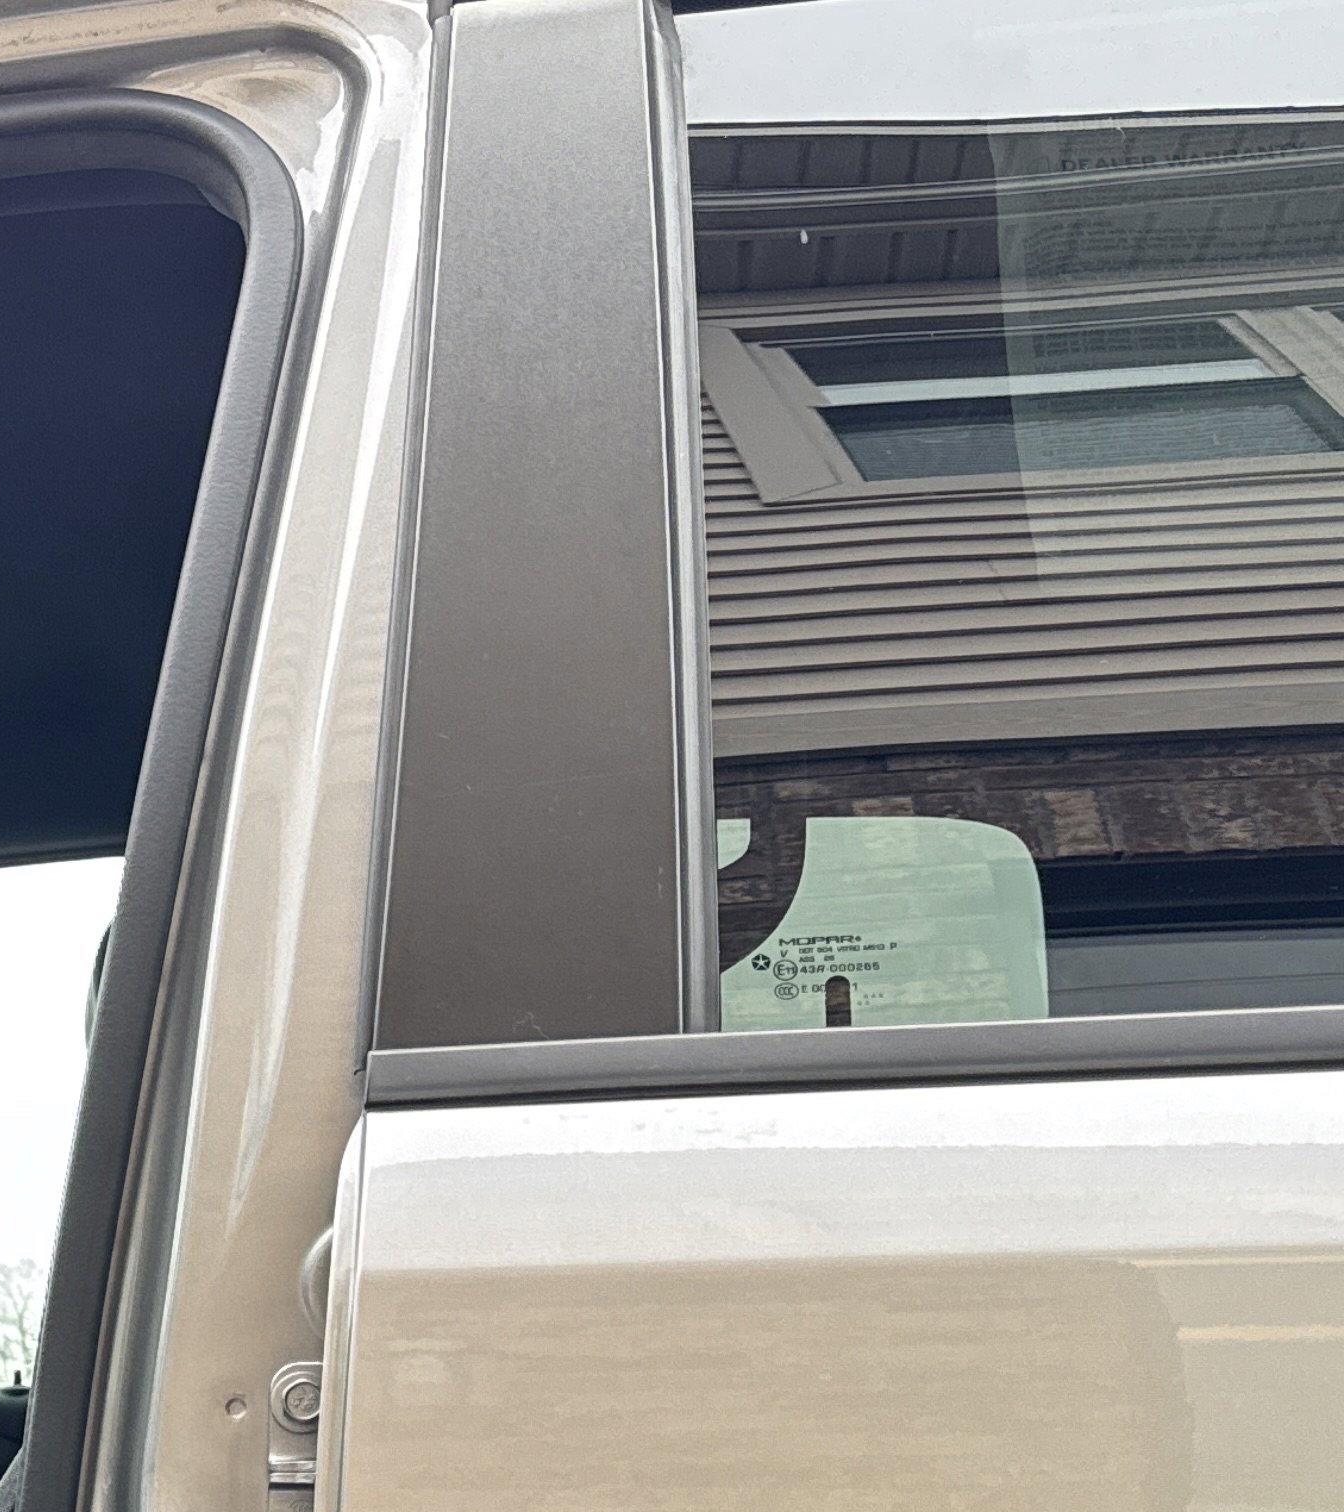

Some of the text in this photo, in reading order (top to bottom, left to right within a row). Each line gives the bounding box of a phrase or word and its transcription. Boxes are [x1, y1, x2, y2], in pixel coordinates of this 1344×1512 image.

[1061, 155, 1156, 172] DEALER
[1167, 139, 1307, 167] WARRANTY
[779, 935, 855, 947] MOPAR
